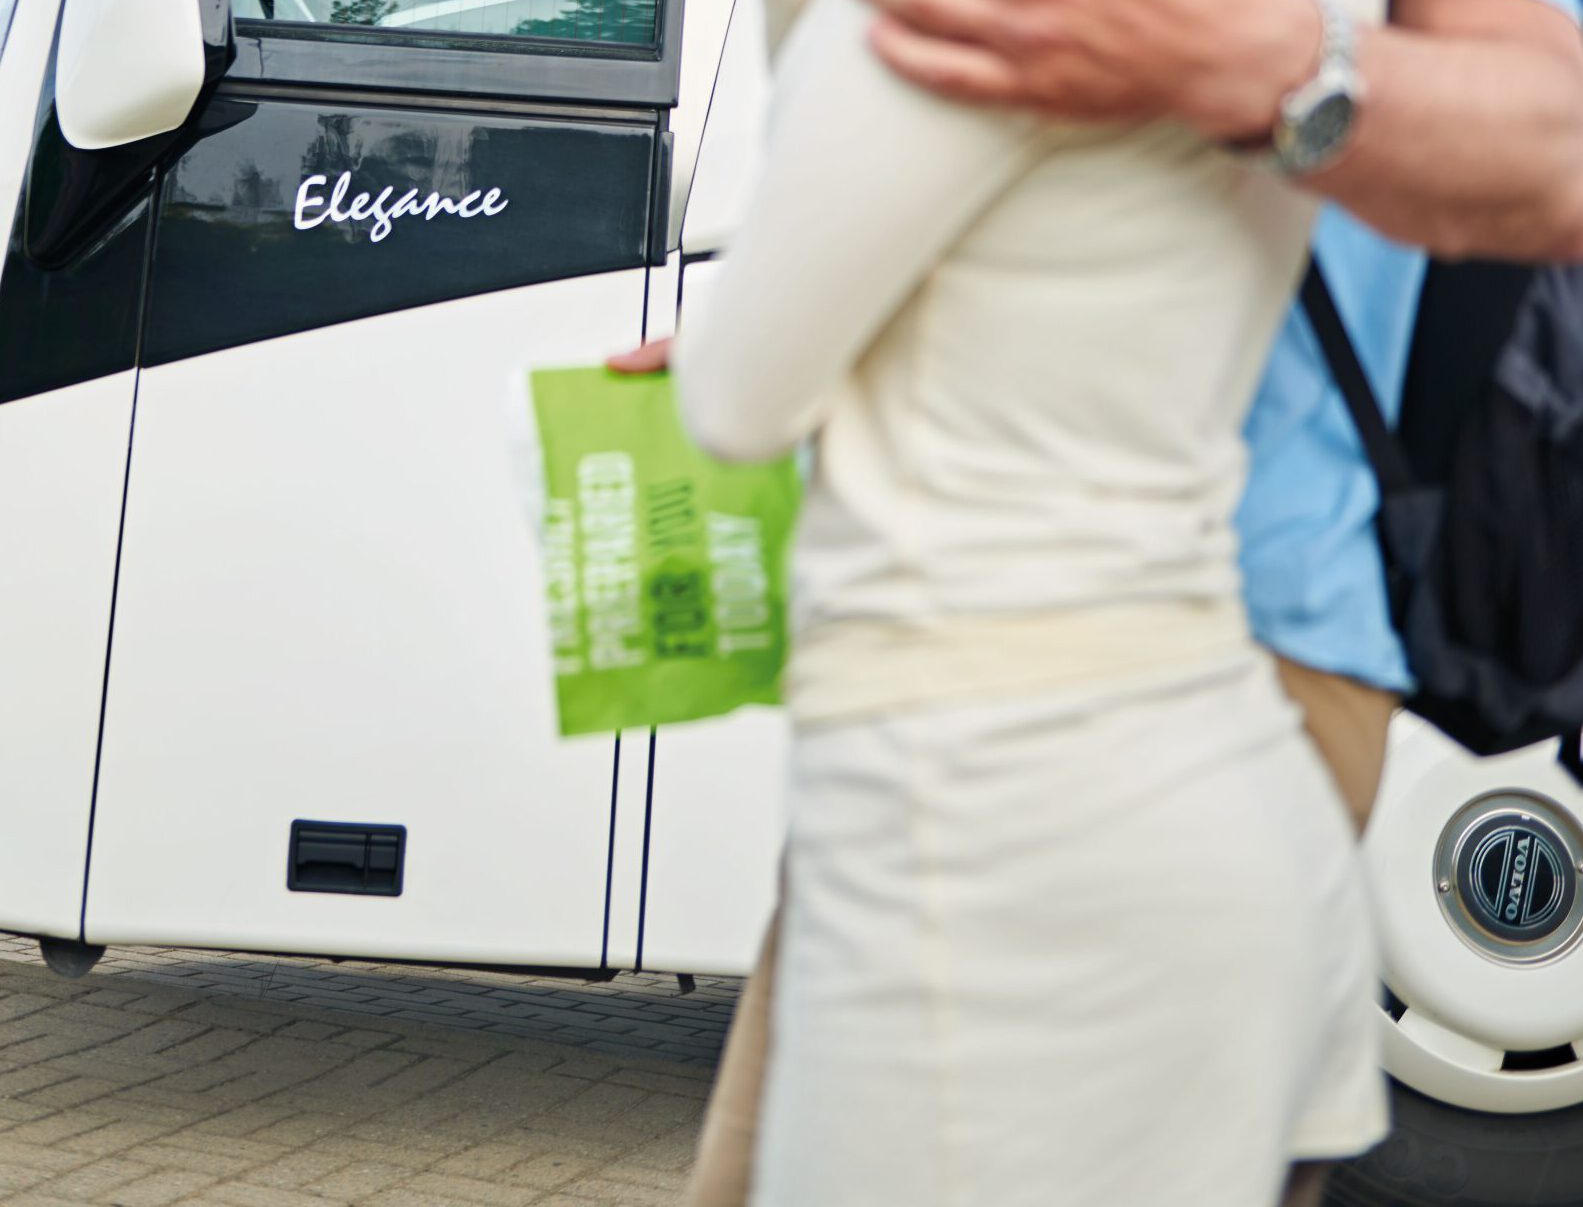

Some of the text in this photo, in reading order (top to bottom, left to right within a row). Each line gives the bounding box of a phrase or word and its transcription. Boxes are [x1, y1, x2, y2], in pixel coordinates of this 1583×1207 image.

[294, 171, 508, 242] Elegance
[577, 450, 648, 671] PREPARED
[647, 477, 707, 659] FOR YOU
[706, 509, 768, 659] TODAY
[1505, 836, 1530, 921] VOLVO
